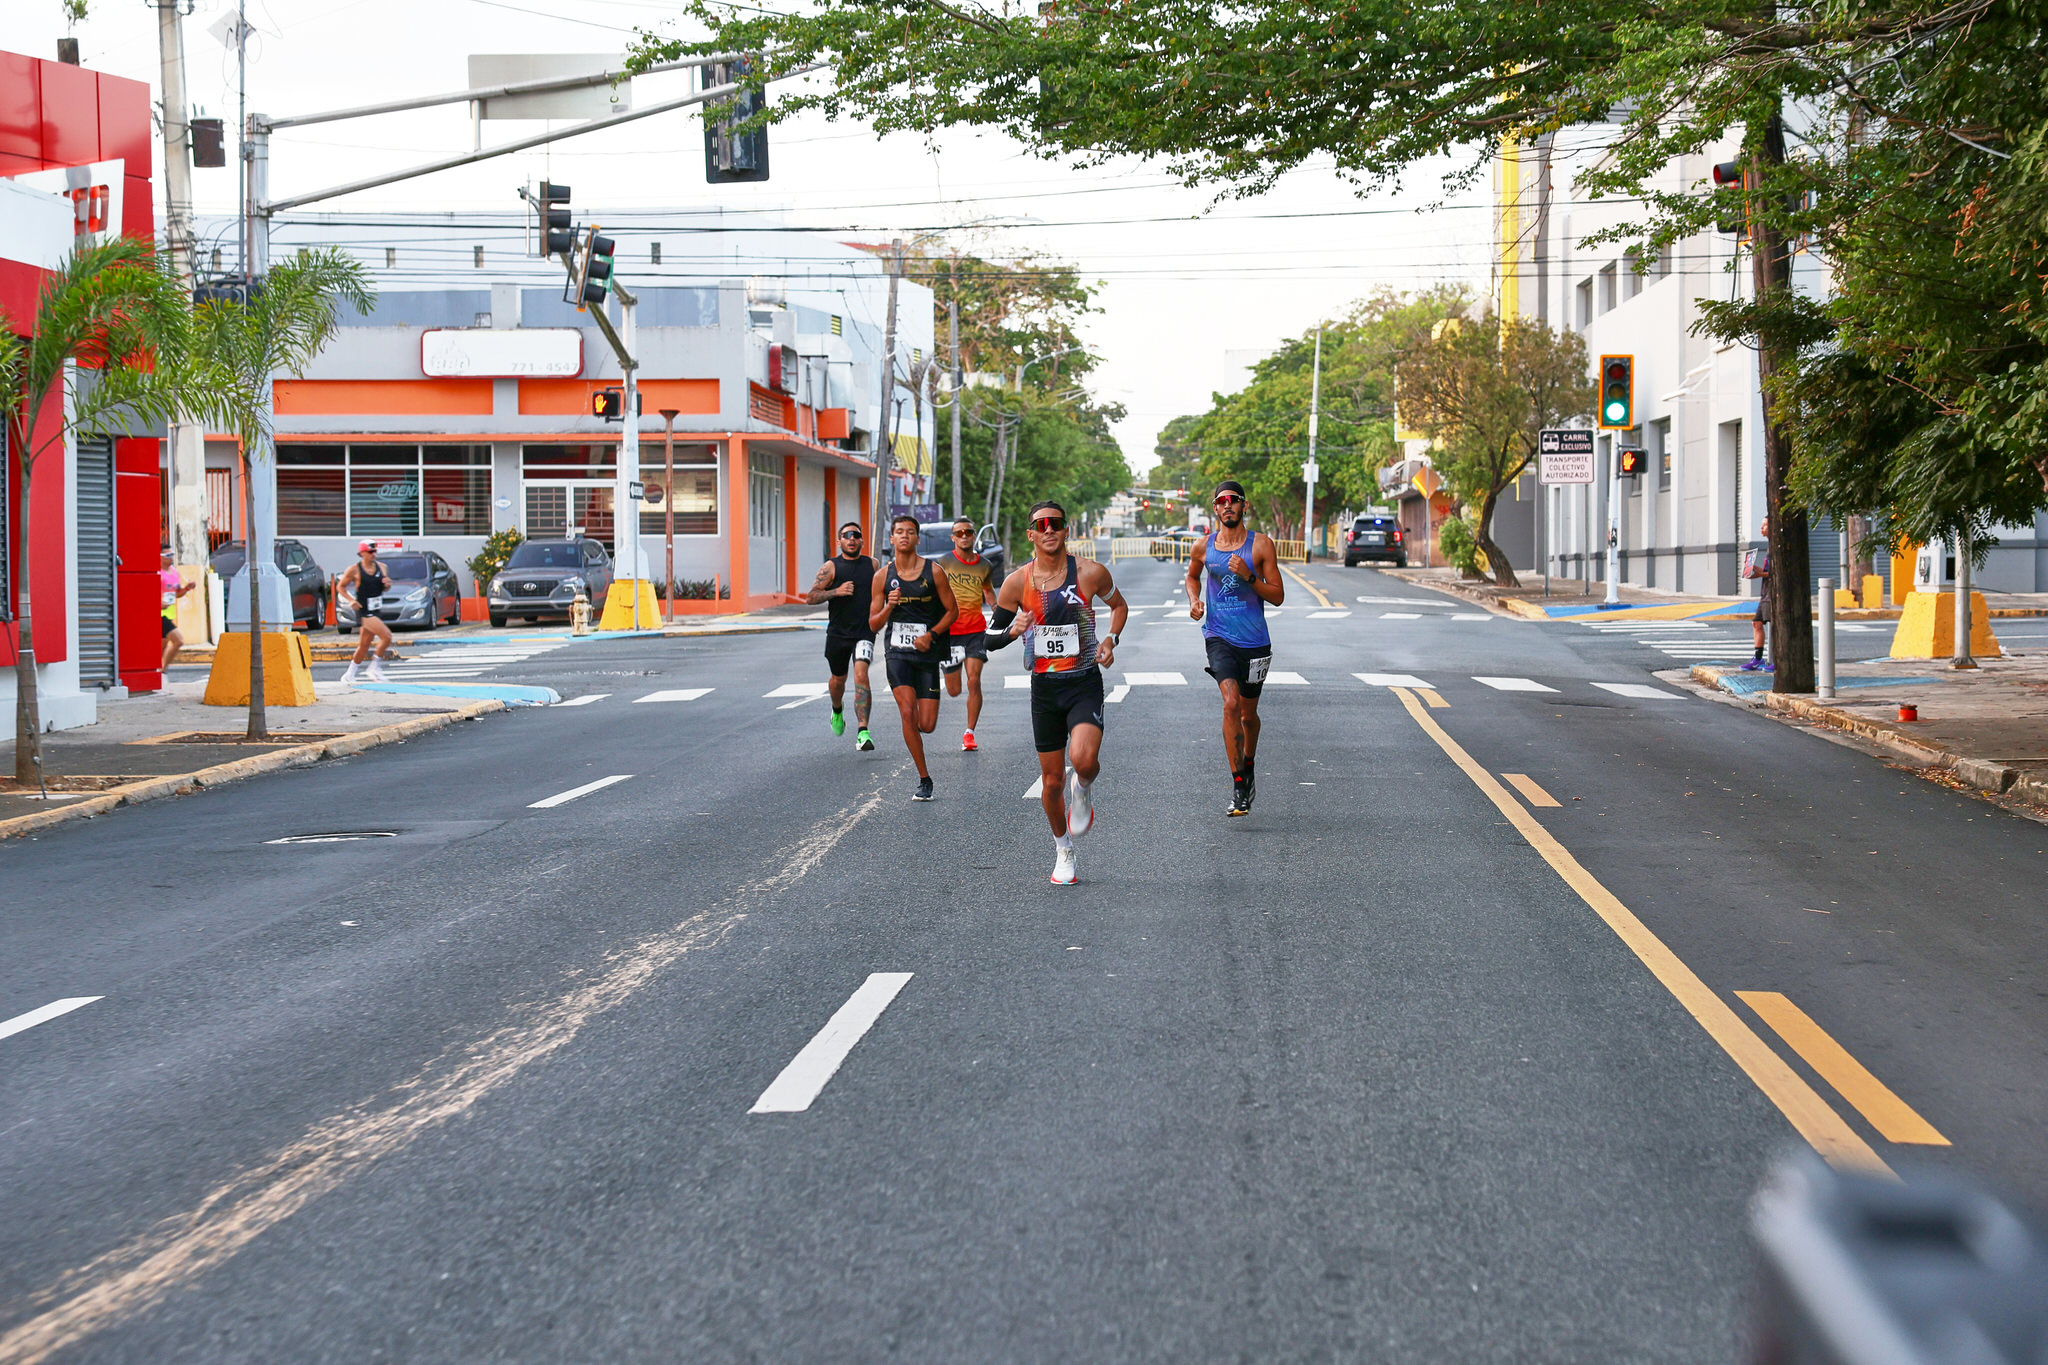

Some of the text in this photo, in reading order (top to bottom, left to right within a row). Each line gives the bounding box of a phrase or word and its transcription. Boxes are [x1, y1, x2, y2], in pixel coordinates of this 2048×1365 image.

[1563, 433, 1589, 441] CARRIL
[381, 484, 418, 498] OPEN
[1047, 640, 1064, 654] 95
